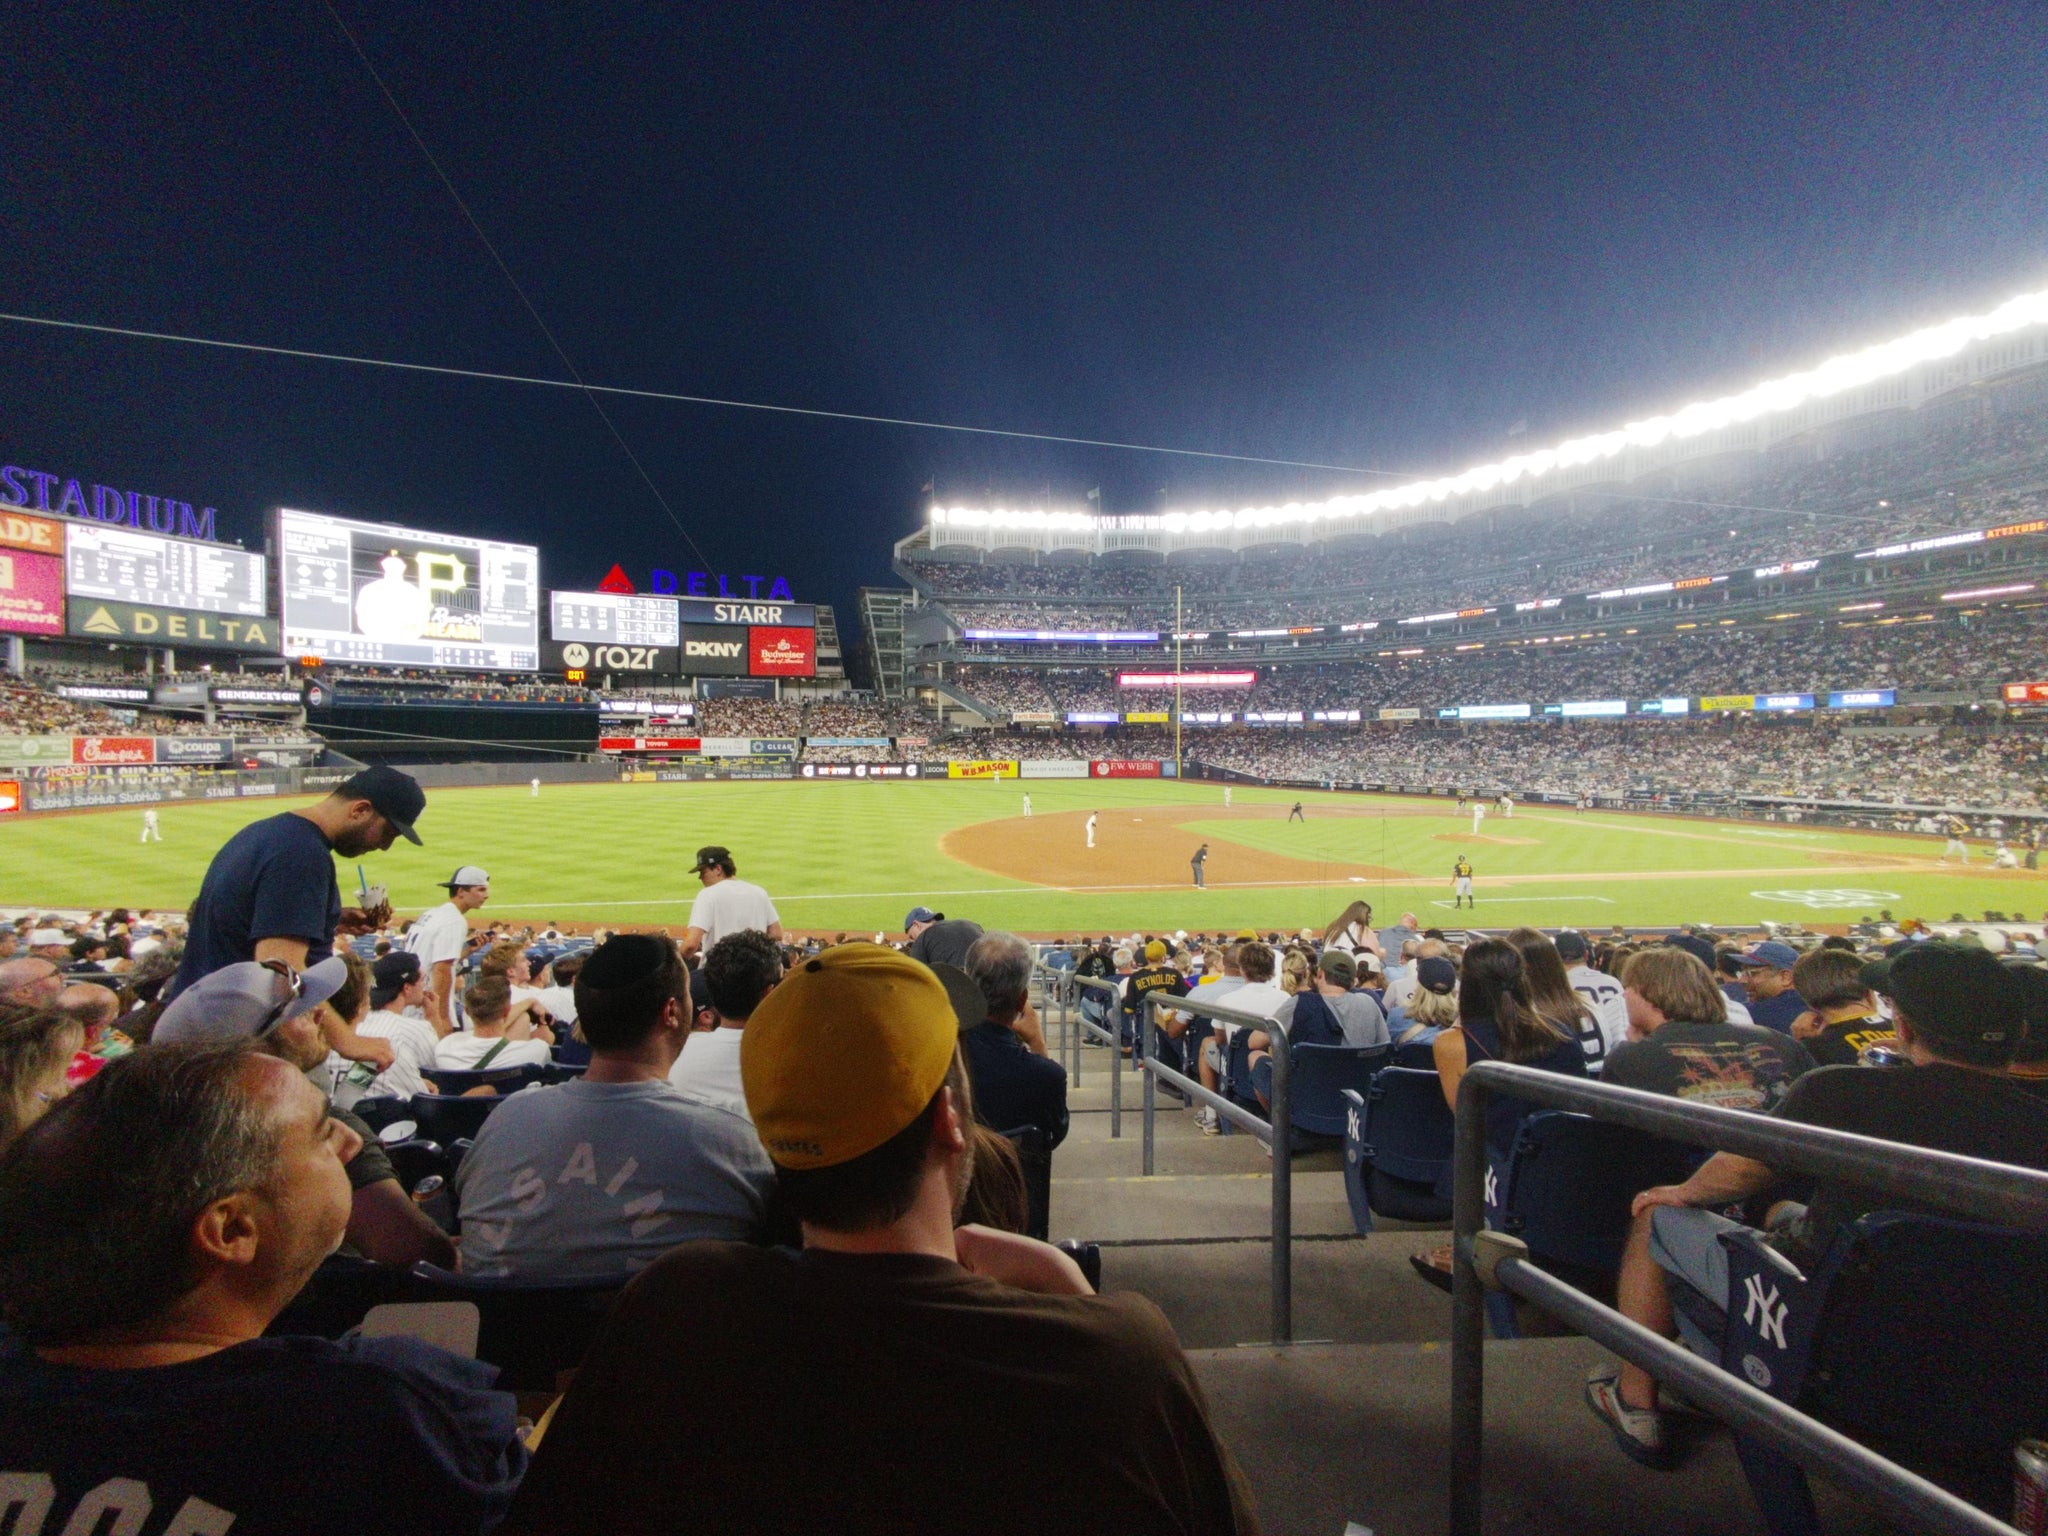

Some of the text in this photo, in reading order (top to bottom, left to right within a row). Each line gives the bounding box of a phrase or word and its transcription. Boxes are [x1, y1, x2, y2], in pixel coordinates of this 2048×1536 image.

[0, 465, 217, 542] STADIUM
[1986, 520, 2046, 539] ATTITUDE
[651, 568, 794, 602] DELTA
[714, 603, 783, 624] STARR
[134, 612, 267, 644] DELTA
[595, 646, 659, 669] razr
[686, 641, 742, 657] DKNY
[761, 649, 805, 659] Budweiser
[129, 690, 149, 699] GIN
[217, 690, 299, 701] HENDRICK'S GIN
[1767, 696, 1800, 707] STARR
[1843, 693, 1880, 704] STARR
[185, 742, 221, 754] coupa
[1129, 762, 1154, 770] WEBB
[32, 798, 72, 810] StubHub
[74, 795, 116, 807] StubHub
[119, 791, 162, 803] StubHub
[206, 787, 236, 797] STARR
[1135, 973, 1177, 991] REYNOLDS
[1743, 1273, 1789, 1349] NY
